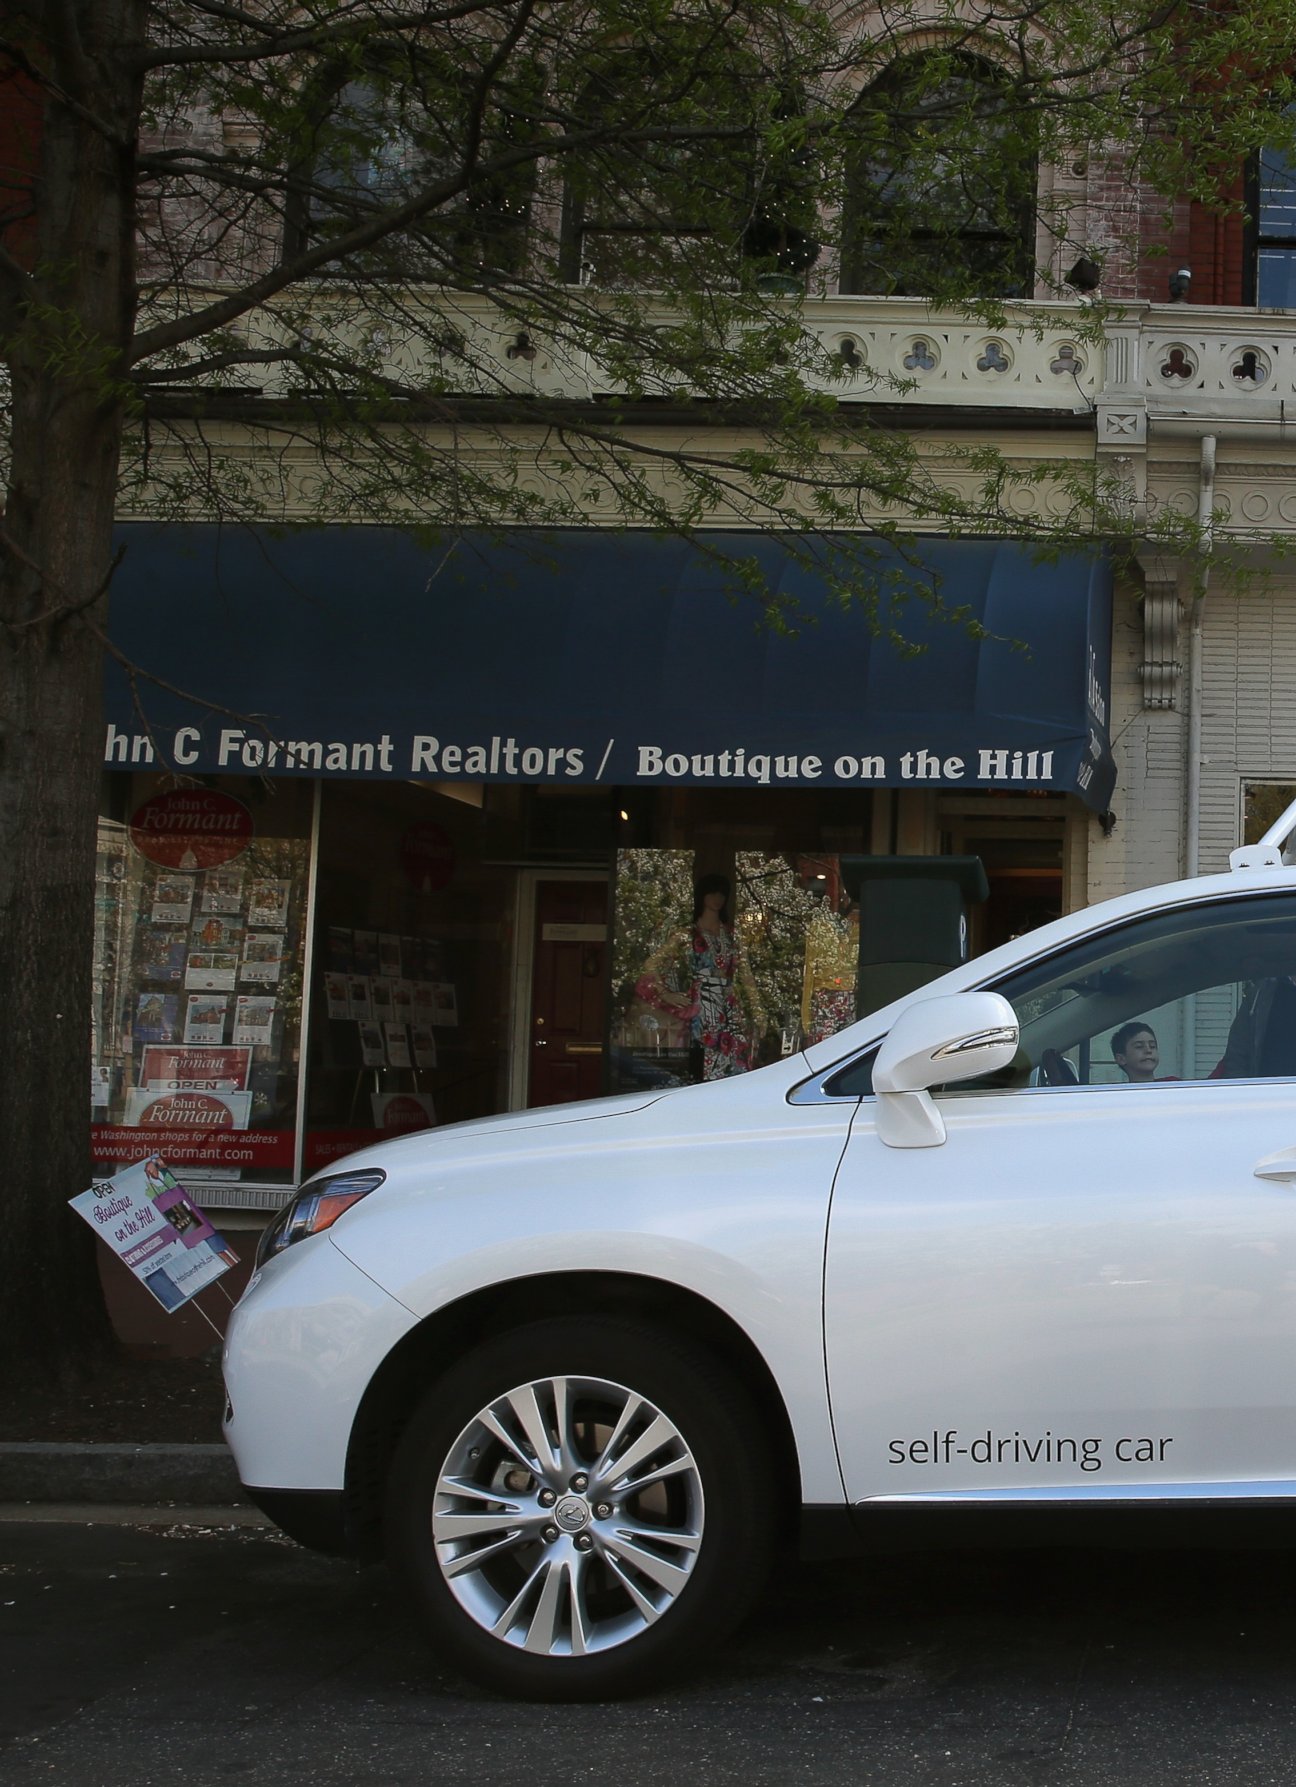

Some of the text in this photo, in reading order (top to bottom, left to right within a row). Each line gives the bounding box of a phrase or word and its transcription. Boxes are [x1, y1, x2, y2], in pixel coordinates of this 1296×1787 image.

[173, 726, 201, 765] C
[218, 729, 395, 772] Formant
[411, 735, 584, 776] Realtors
[637, 746, 823, 783] Boutique
[834, 755, 886, 779] on
[899, 749, 965, 779] the
[977, 749, 1054, 780] Hill
[140, 807, 242, 830] Formant
[167, 1056, 225, 1069] Formant
[167, 1080, 218, 1090] OPEN
[169, 1098, 196, 1110] John
[149, 1104, 228, 1124] Formant
[100, 1130, 158, 1142] Washington
[159, 1131, 190, 1143] shops
[191, 1131, 206, 1142] for
[209, 1134, 215, 1142] a
[217, 1134, 237, 1143] new
[239, 1133, 278, 1144] address
[94, 1144, 253, 1161] www.johncformant.com
[92, 1182, 116, 1199] OPEN
[93, 1195, 133, 1224] Boutique
[115, 1206, 156, 1242] on the Hill
[888, 1430, 1173, 1472] self-driving car
